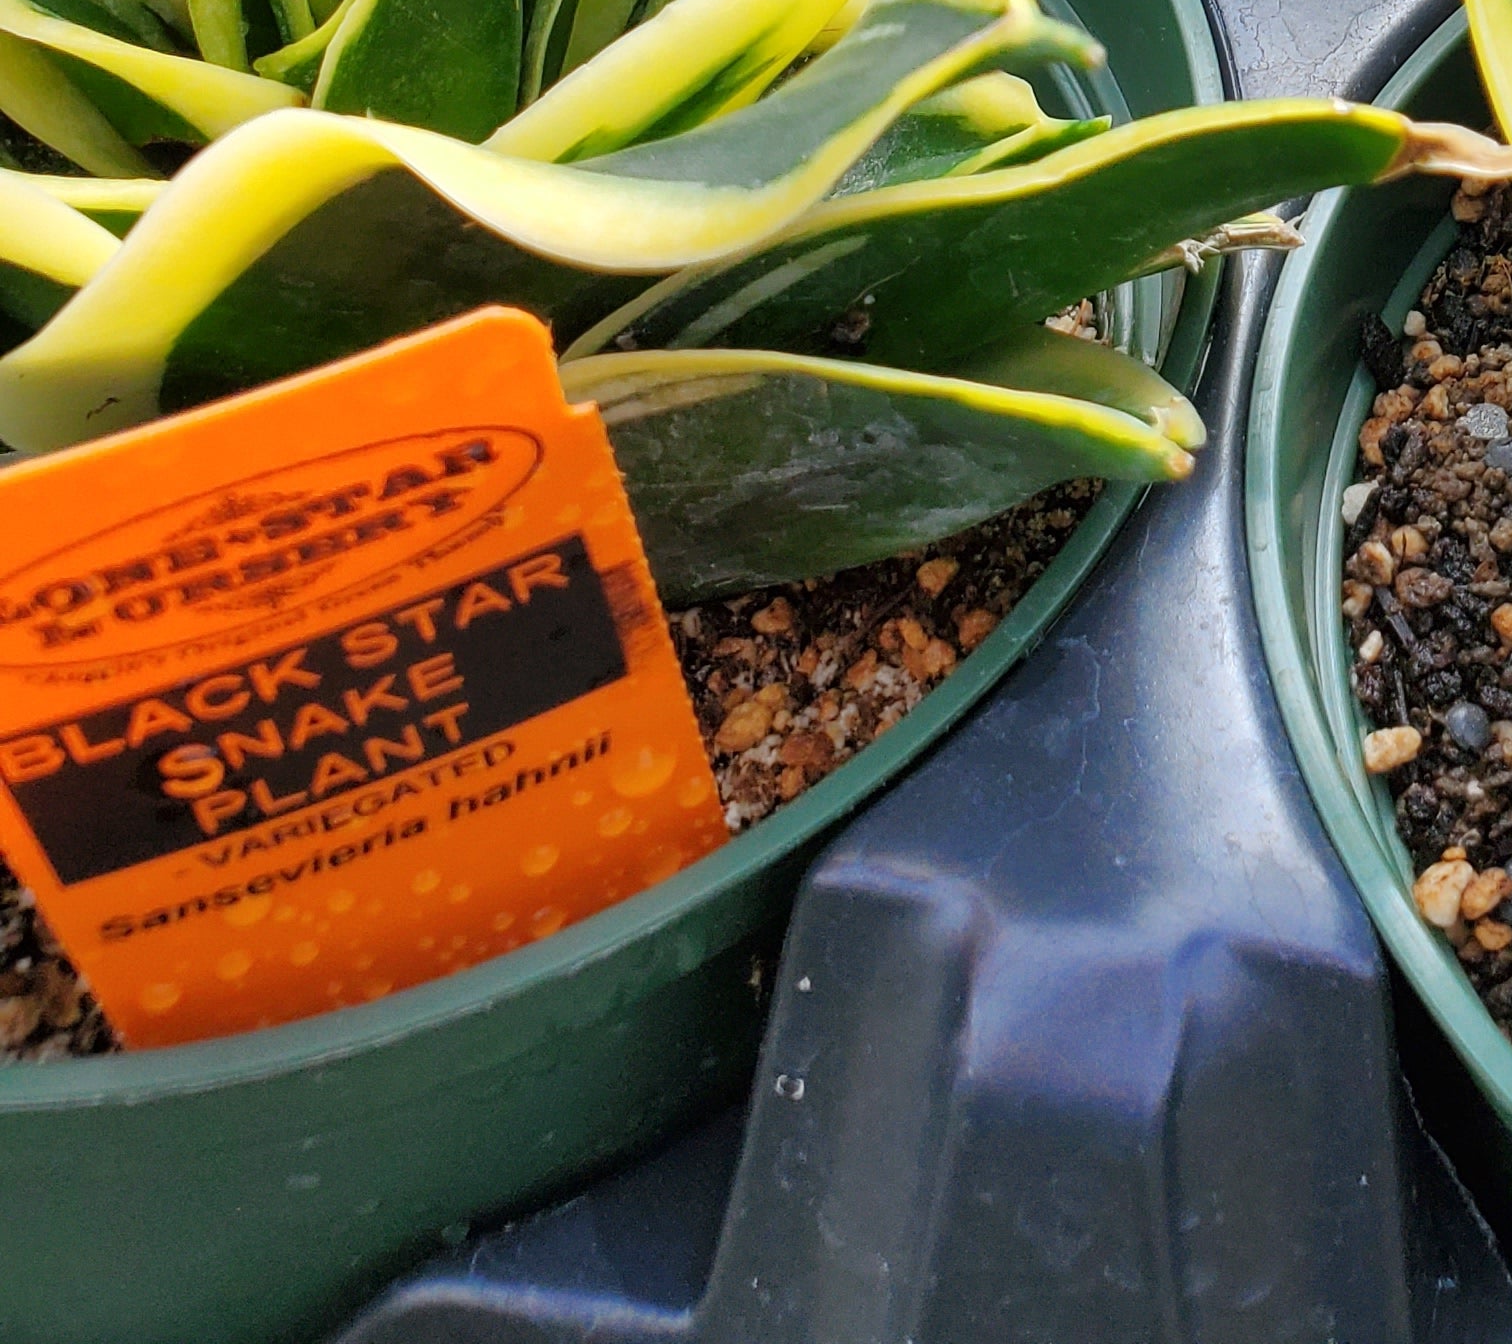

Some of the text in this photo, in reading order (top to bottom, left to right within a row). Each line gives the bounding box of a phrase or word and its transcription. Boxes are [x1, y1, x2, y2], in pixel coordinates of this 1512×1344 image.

[258, 437, 498, 540] STAR
[2, 552, 571, 782] BLACK STAR
[157, 652, 465, 799] SNAKE
[100, 730, 613, 940] Sansevieria hahnii
[193, 703, 471, 835] PLANT
[200, 739, 516, 868] VARIEGATED
